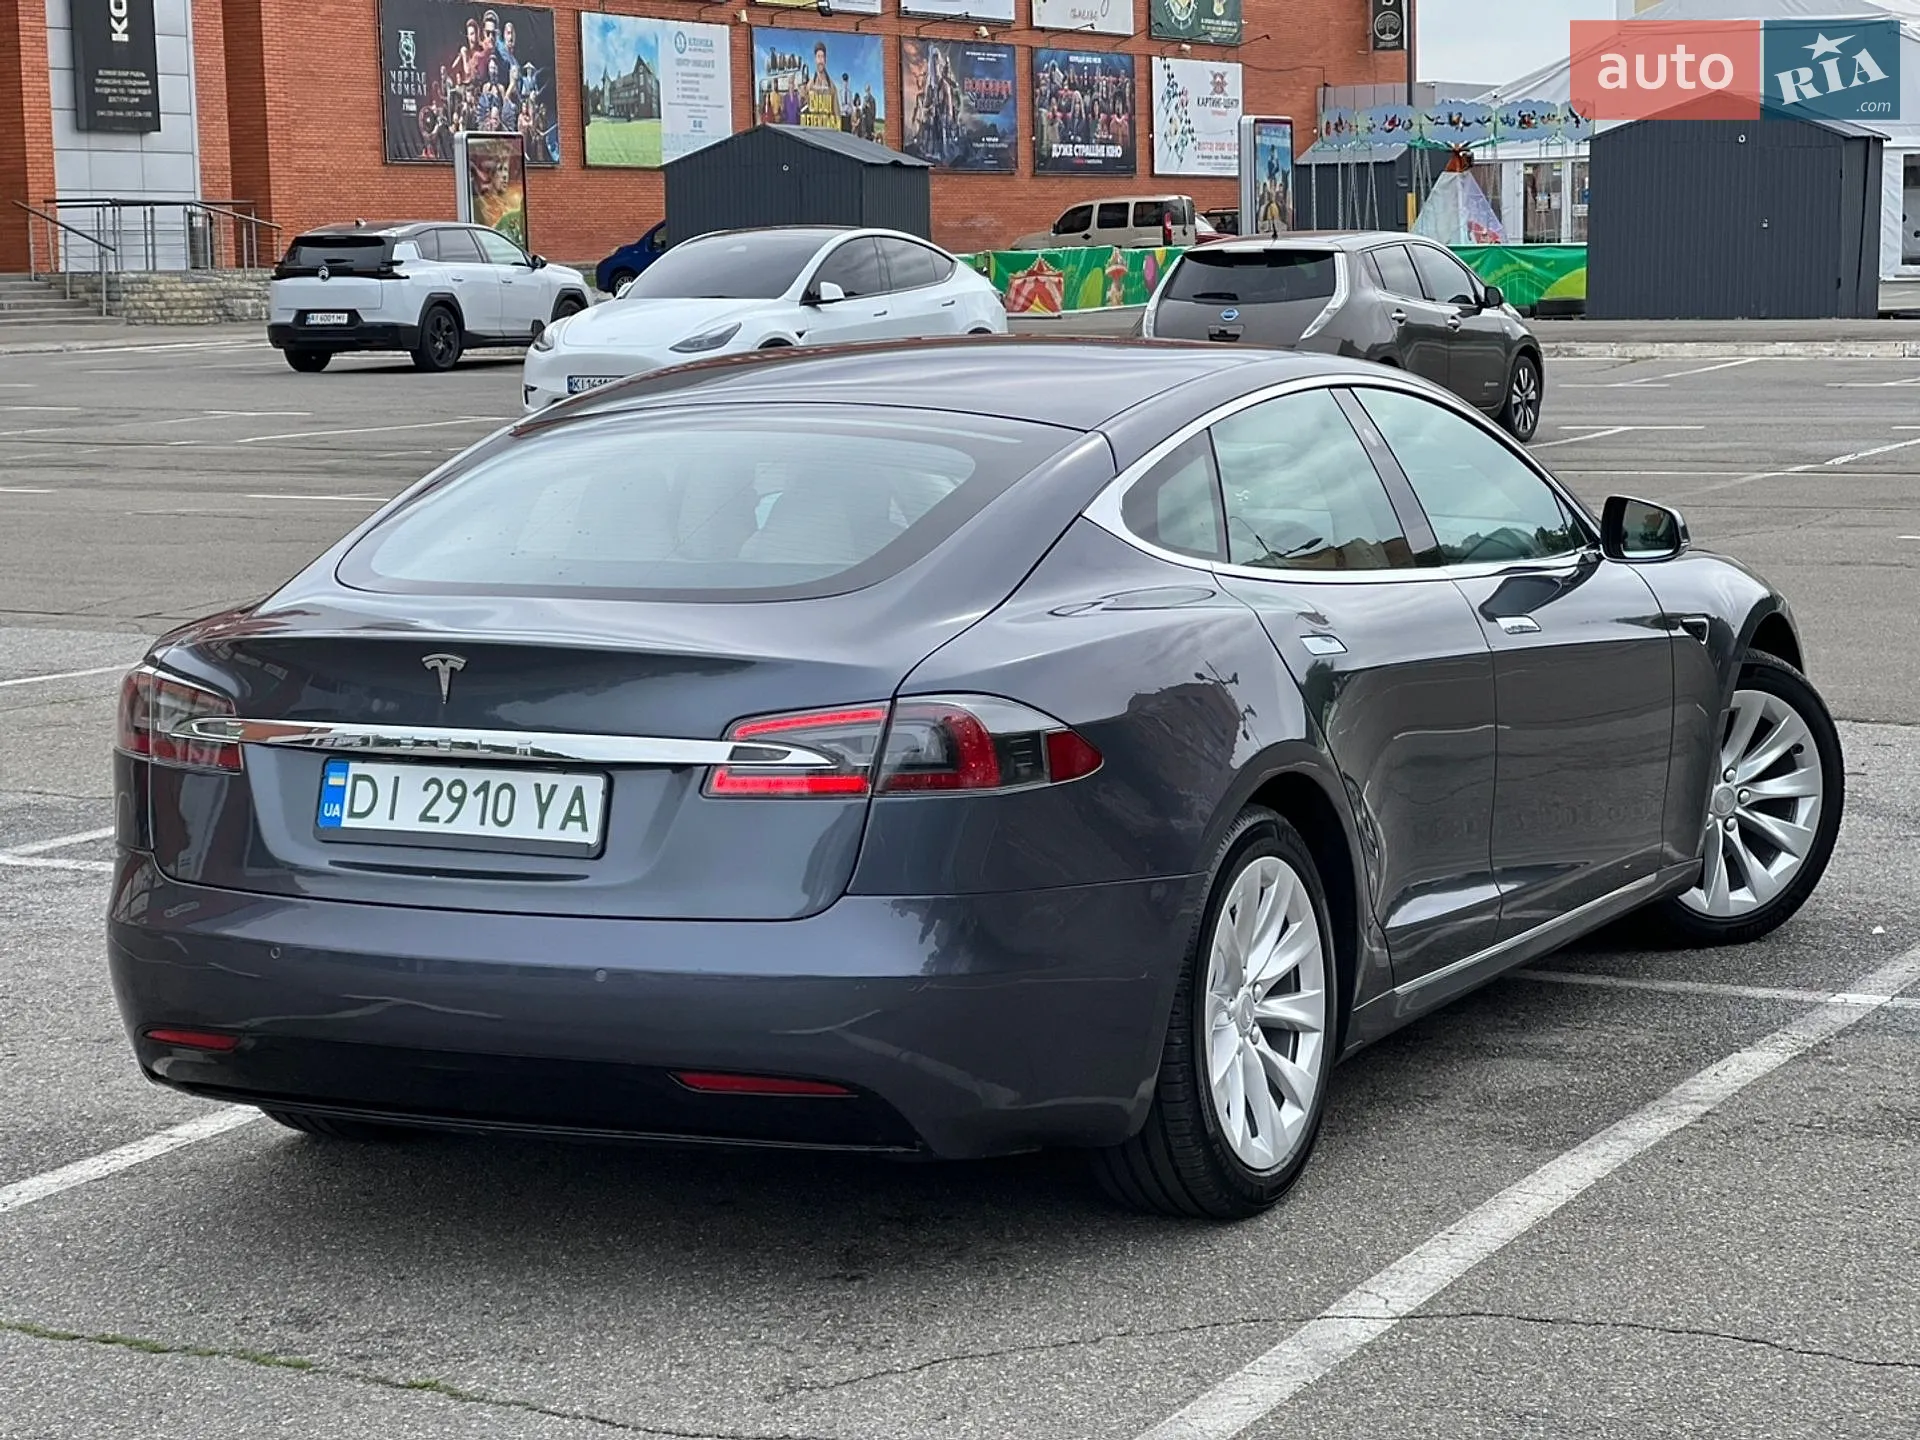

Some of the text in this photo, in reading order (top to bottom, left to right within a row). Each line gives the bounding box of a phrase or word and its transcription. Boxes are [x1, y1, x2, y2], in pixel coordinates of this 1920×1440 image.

[1051, 143, 1073, 158] ДУЖЕ
[324, 803, 340, 817] UA
[347, 774, 589, 832] DI 2910 YA
